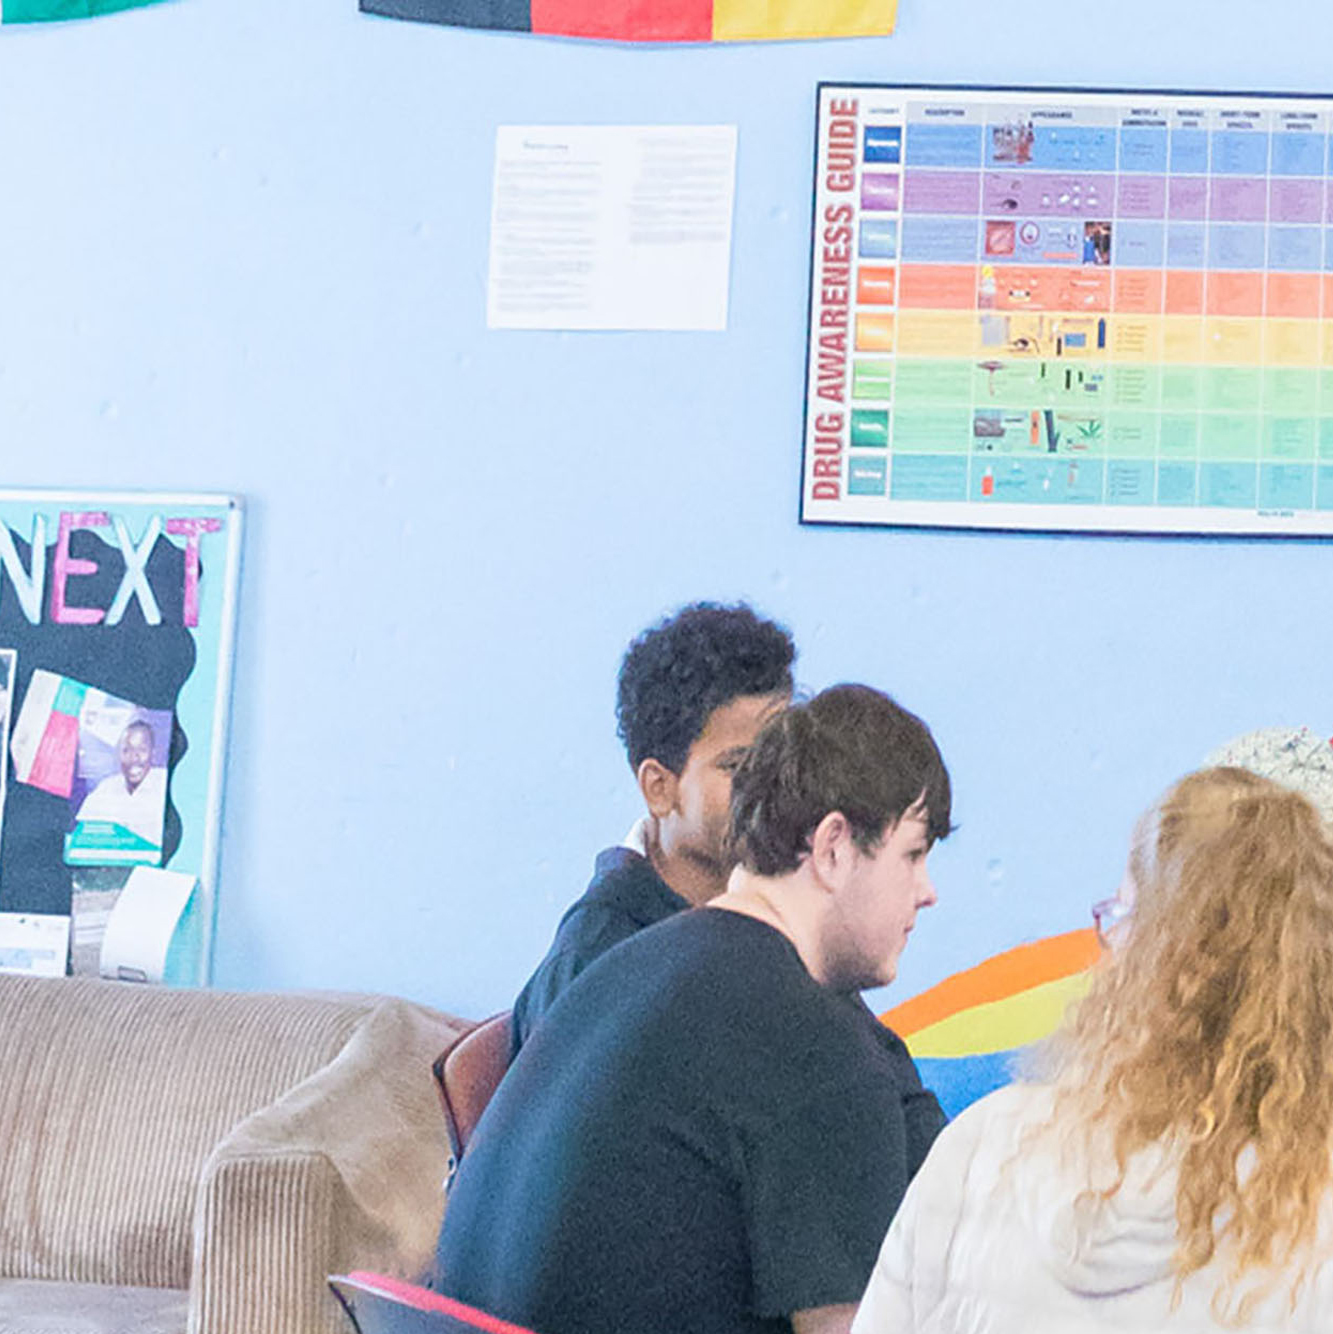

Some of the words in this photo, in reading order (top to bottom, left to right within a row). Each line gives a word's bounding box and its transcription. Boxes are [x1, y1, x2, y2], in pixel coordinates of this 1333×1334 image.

[826, 98, 858, 192] GUIDE
[817, 203, 854, 404] AWARENESS
[812, 413, 844, 500] DRUG
[0, 511, 223, 627] NEXT
